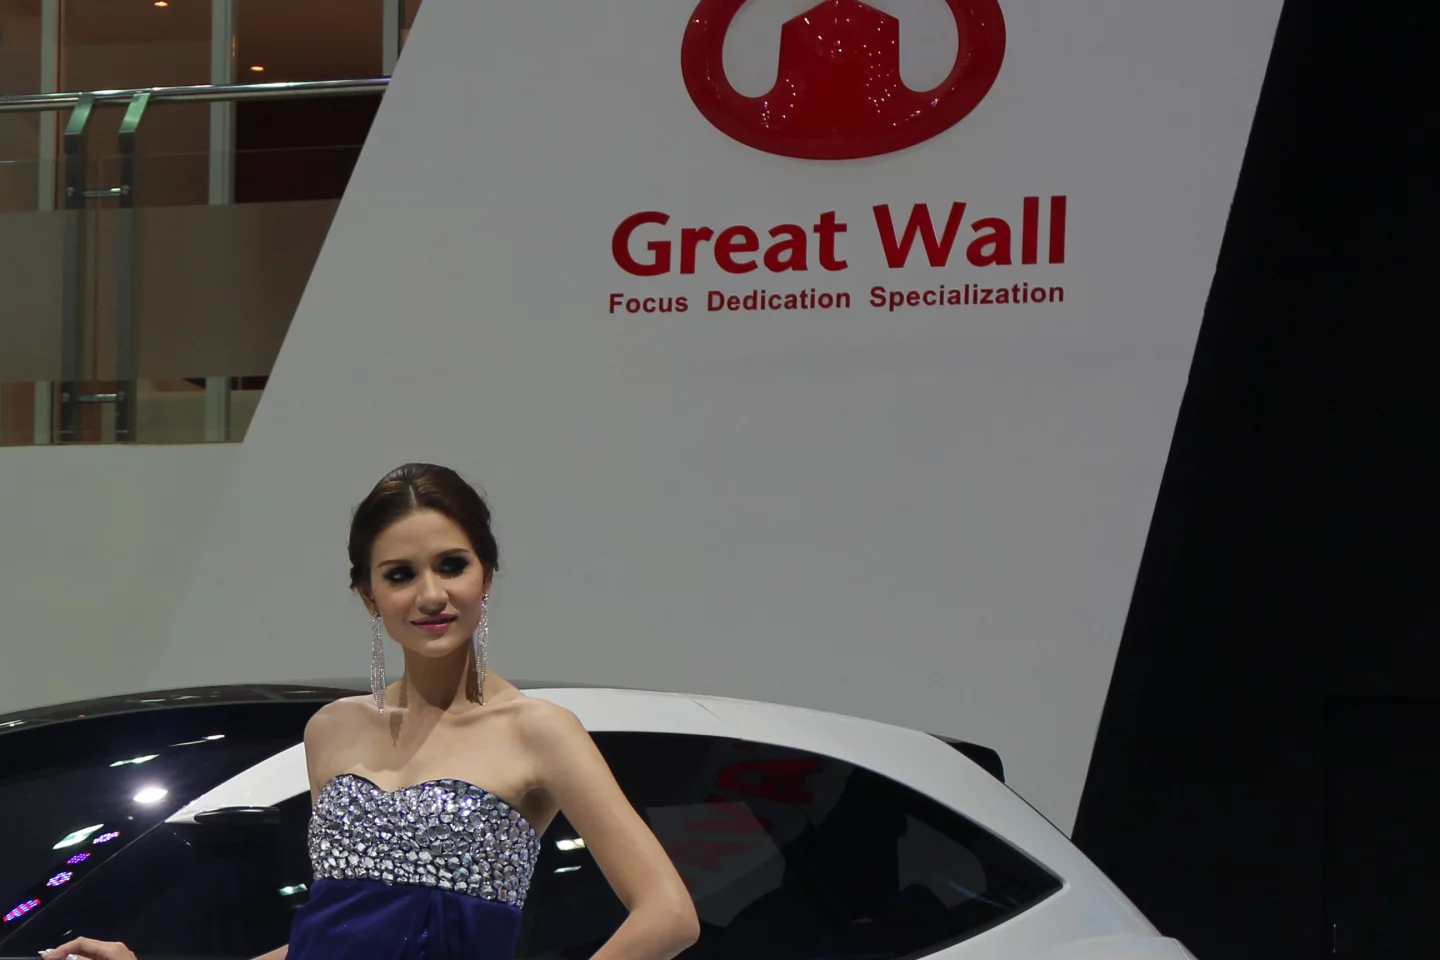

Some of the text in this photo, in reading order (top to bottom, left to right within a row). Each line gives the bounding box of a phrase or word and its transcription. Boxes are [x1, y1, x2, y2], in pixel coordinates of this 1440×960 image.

[611, 195, 1067, 277] Great Wall
[609, 282, 1065, 314] Focus Dedication Specialization
